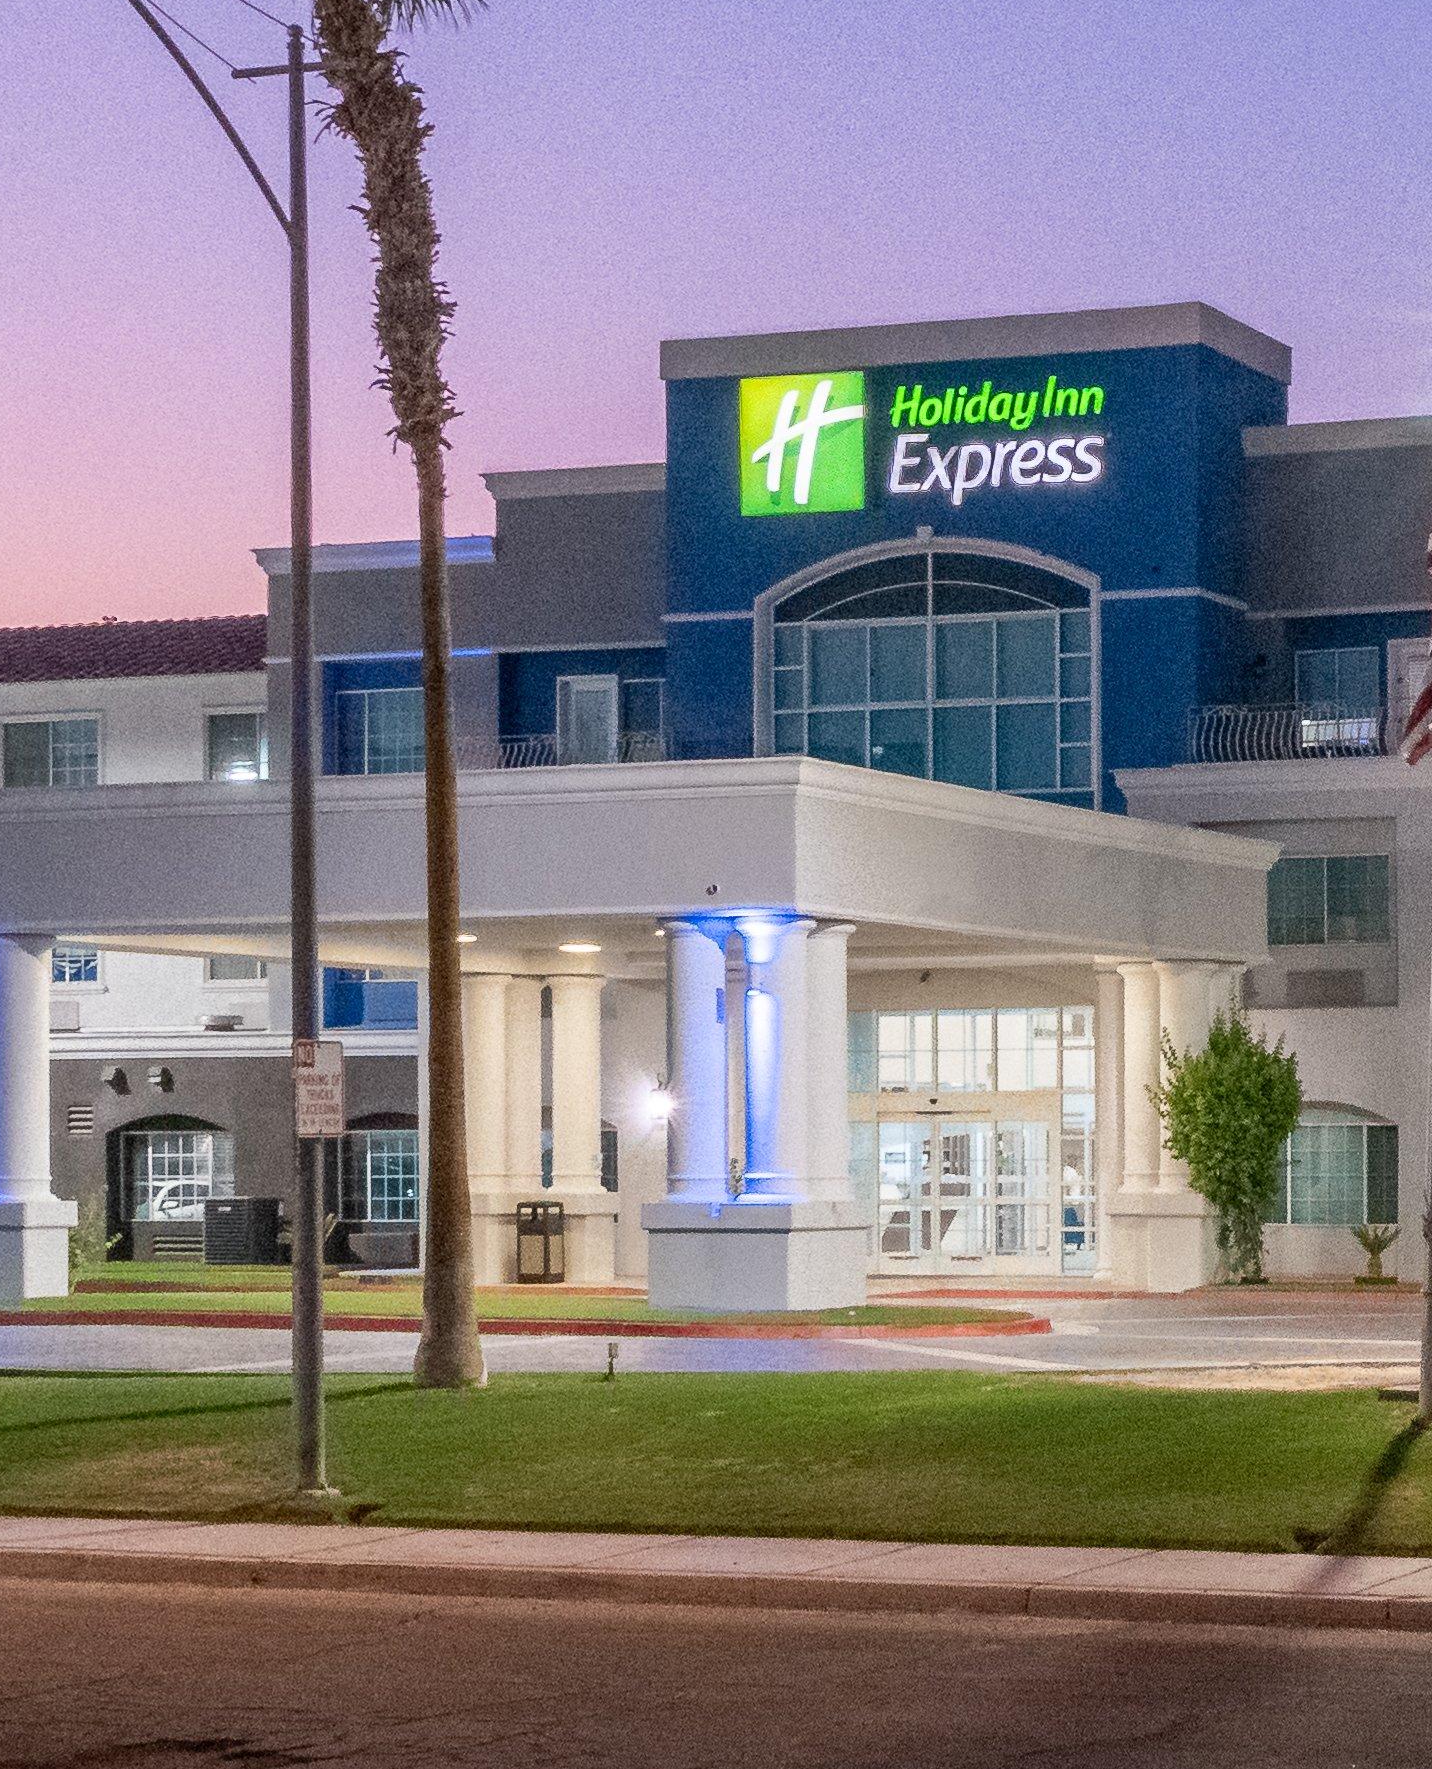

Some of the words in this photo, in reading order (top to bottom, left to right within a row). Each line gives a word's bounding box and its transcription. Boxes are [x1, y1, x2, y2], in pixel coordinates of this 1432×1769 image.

[890, 381, 1039, 430] Holiday
[1042, 375, 1105, 418] Inn
[888, 433, 1106, 506] Express
